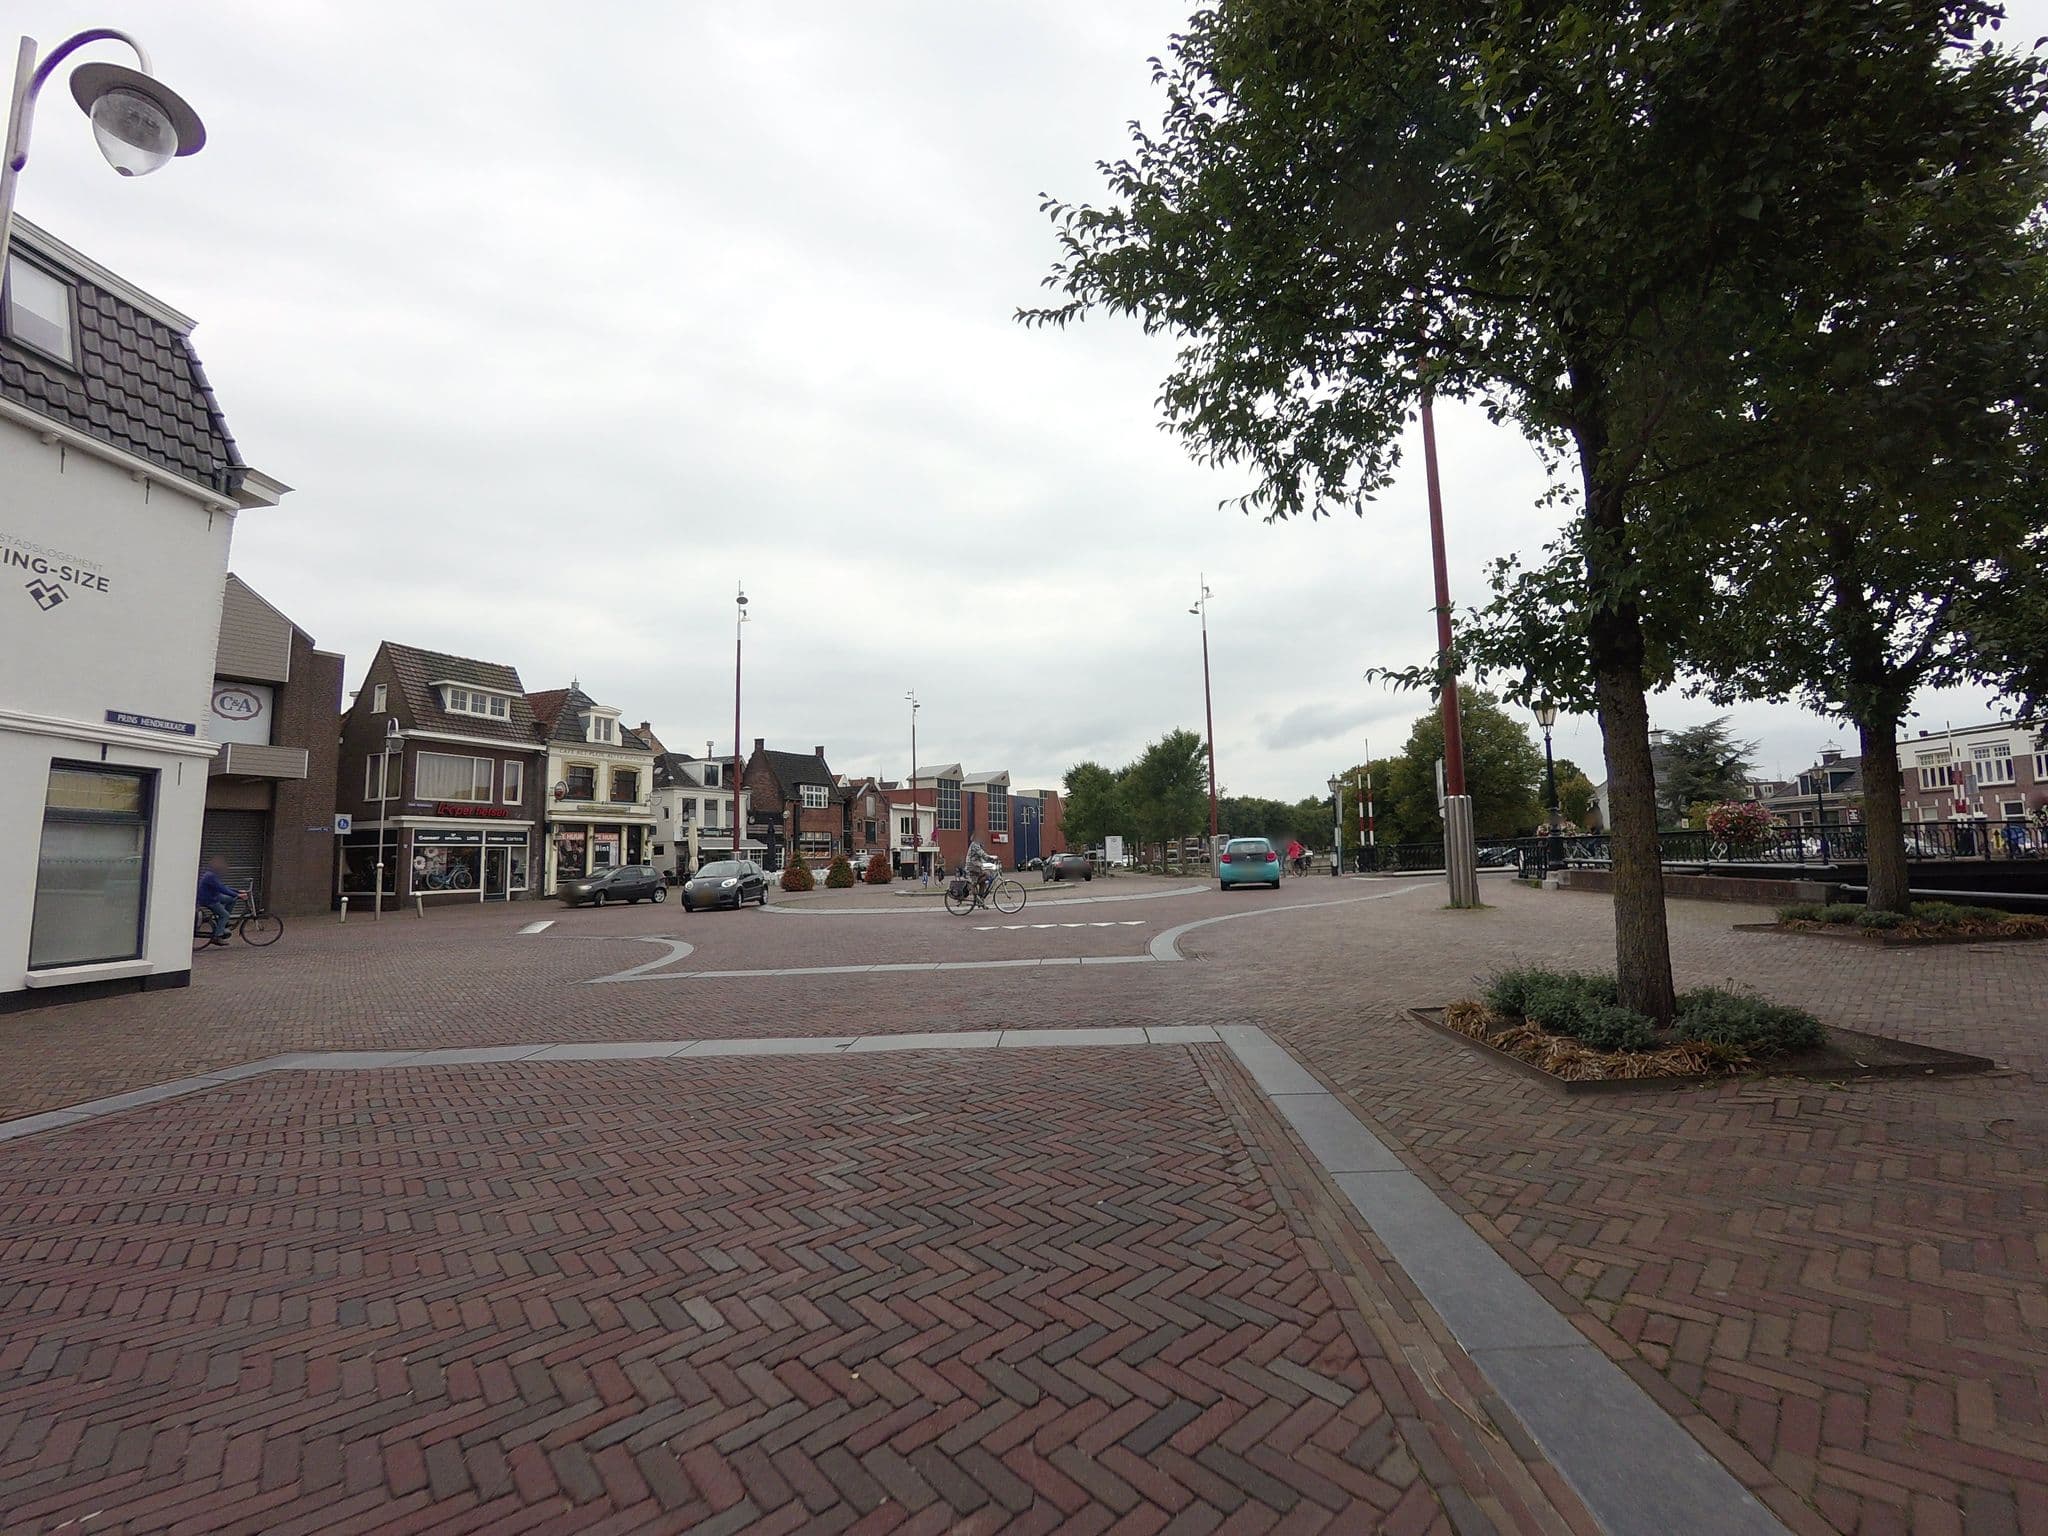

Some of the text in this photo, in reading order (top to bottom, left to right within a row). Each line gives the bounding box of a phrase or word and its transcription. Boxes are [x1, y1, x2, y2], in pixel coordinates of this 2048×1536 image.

[0, 546, 110, 593] ING-SIZE
[220, 696, 253, 713] C&A
[117, 714, 138, 724] PRINS
